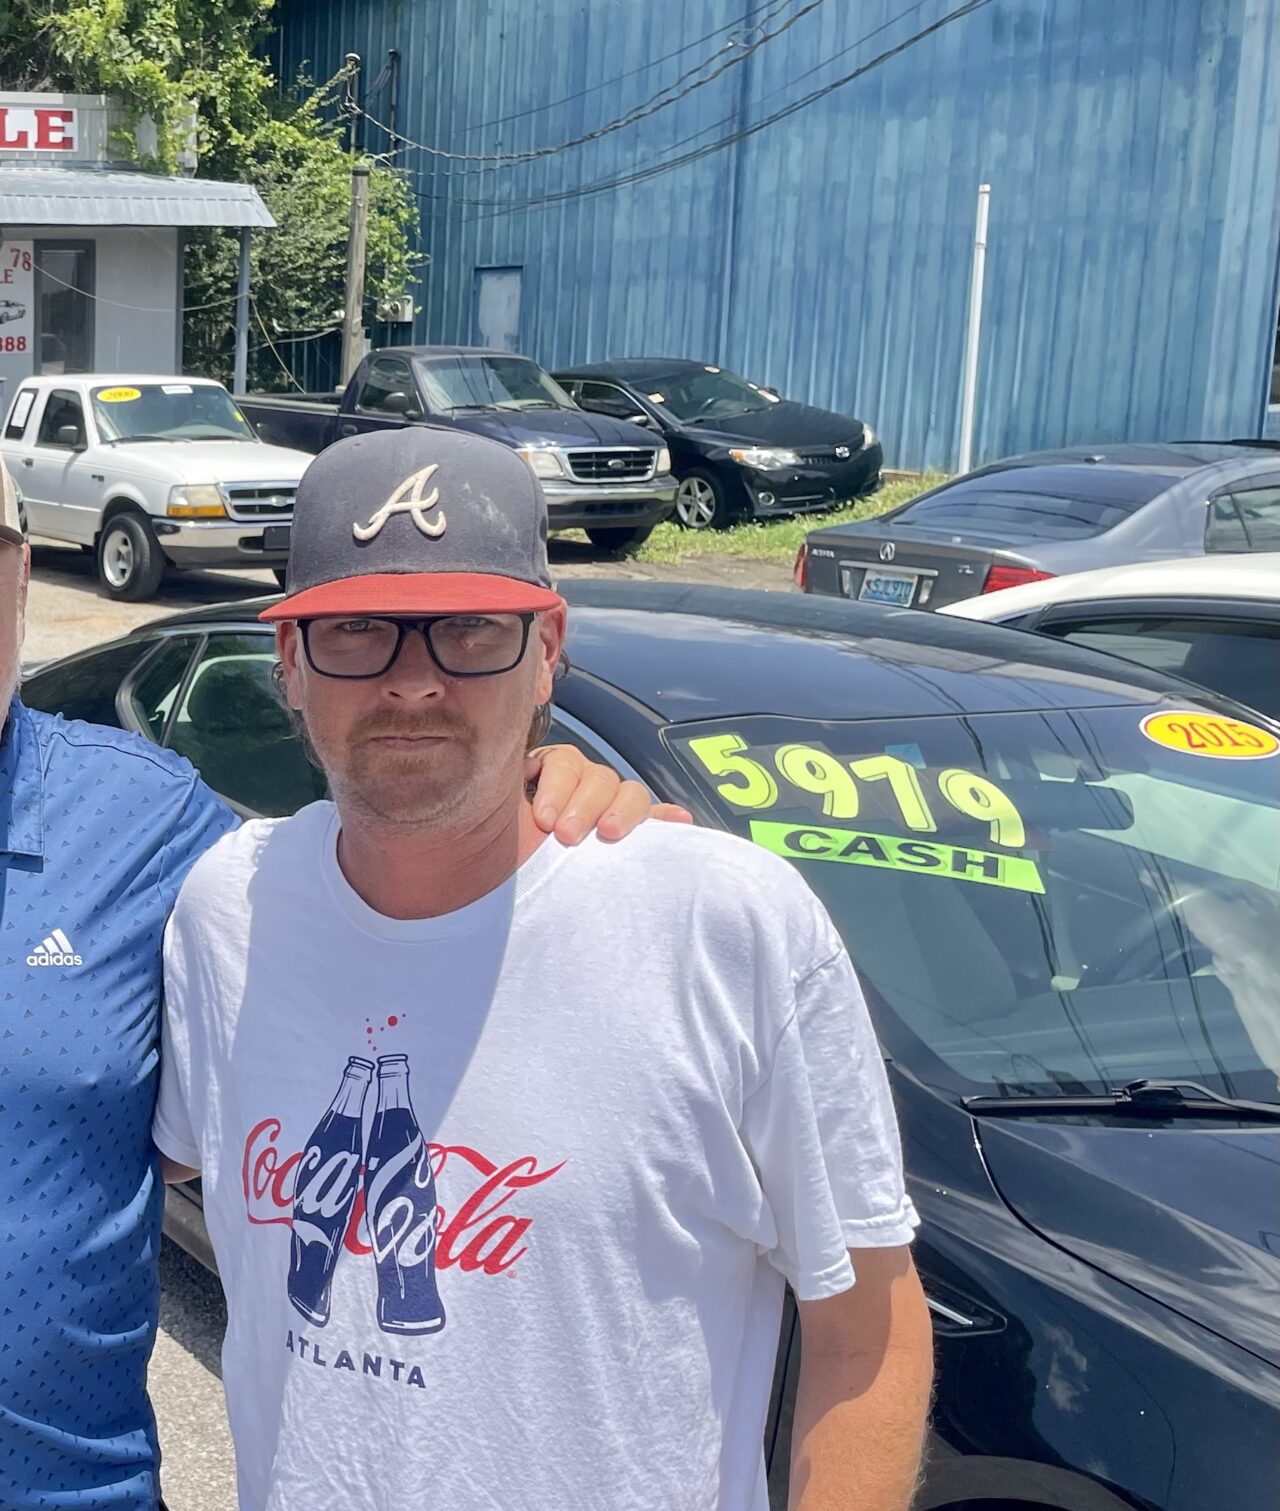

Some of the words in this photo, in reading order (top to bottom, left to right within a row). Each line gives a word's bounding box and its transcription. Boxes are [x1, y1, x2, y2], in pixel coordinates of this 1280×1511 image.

[10, 248, 32, 272] 78
[352, 463, 447, 541] A
[1167, 721, 1264, 749] 2015
[688, 734, 1026, 848] 5979
[783, 829, 1001, 880] CASH
[26, 951, 83, 967] adidas
[285, 1329, 427, 1389] ATLANTA
